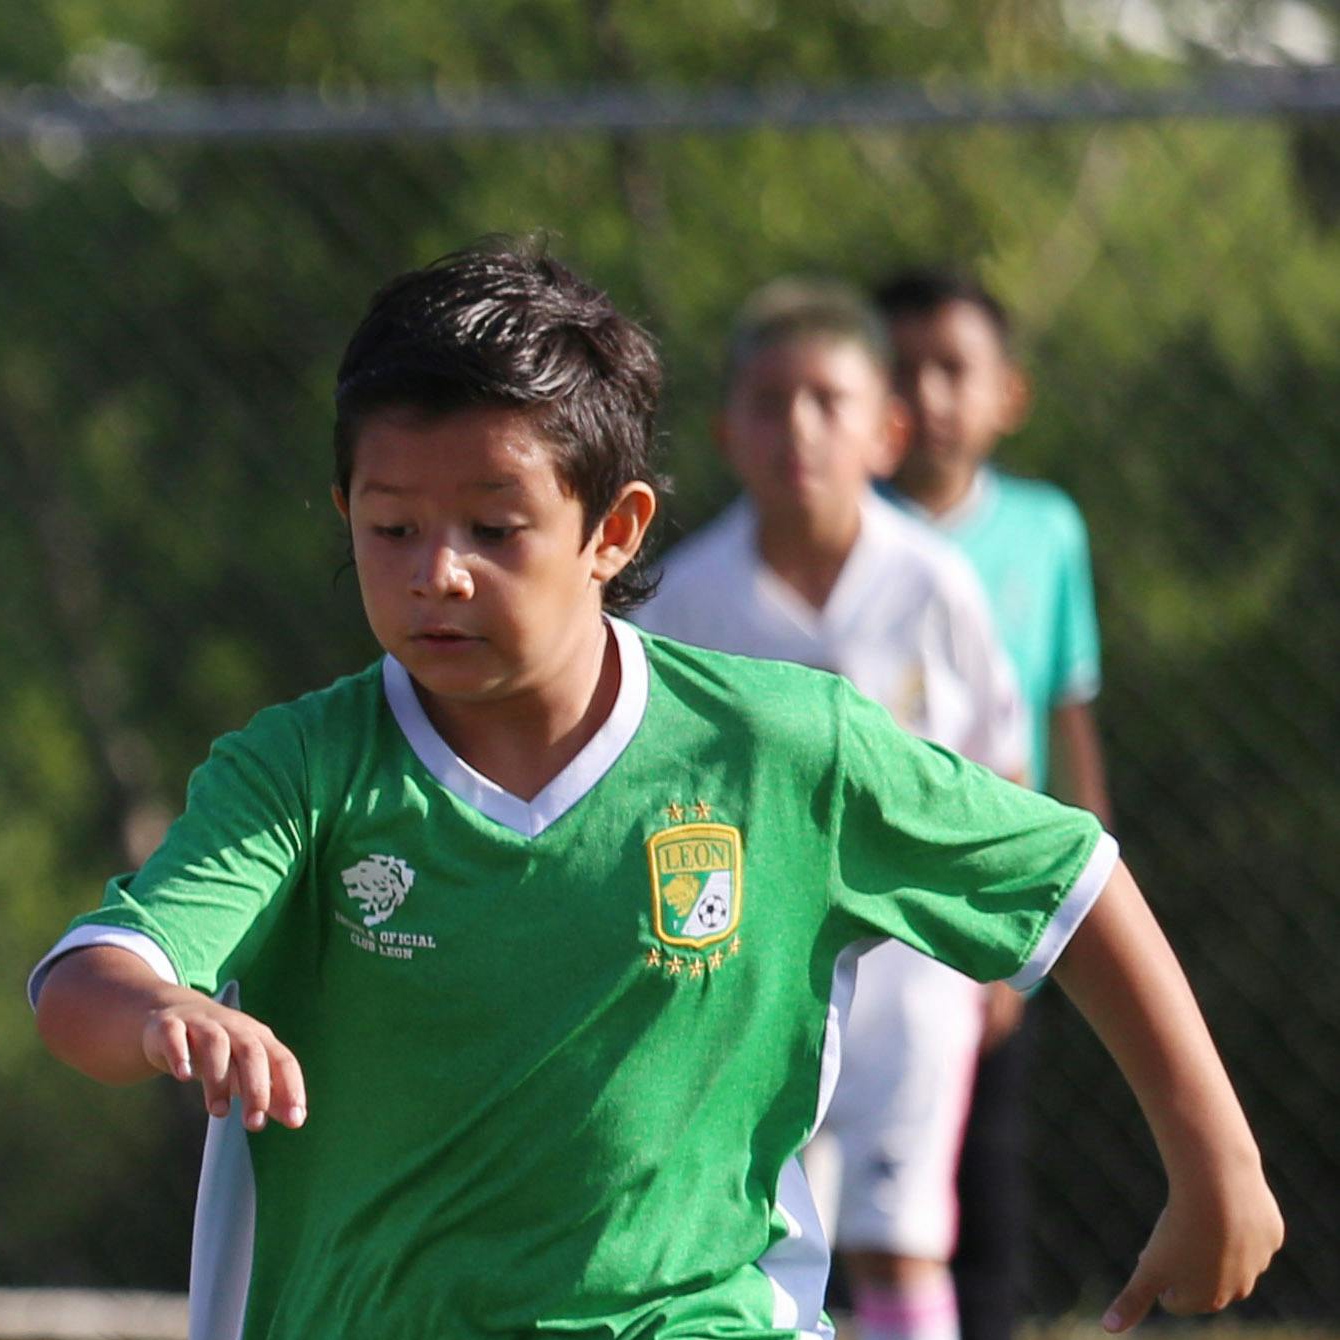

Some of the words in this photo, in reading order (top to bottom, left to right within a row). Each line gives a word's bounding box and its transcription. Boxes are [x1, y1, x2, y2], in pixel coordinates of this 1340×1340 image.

[666, 842, 726, 869] LEON
[380, 931, 436, 948] OFICIAL
[379, 945, 412, 960] LEON
